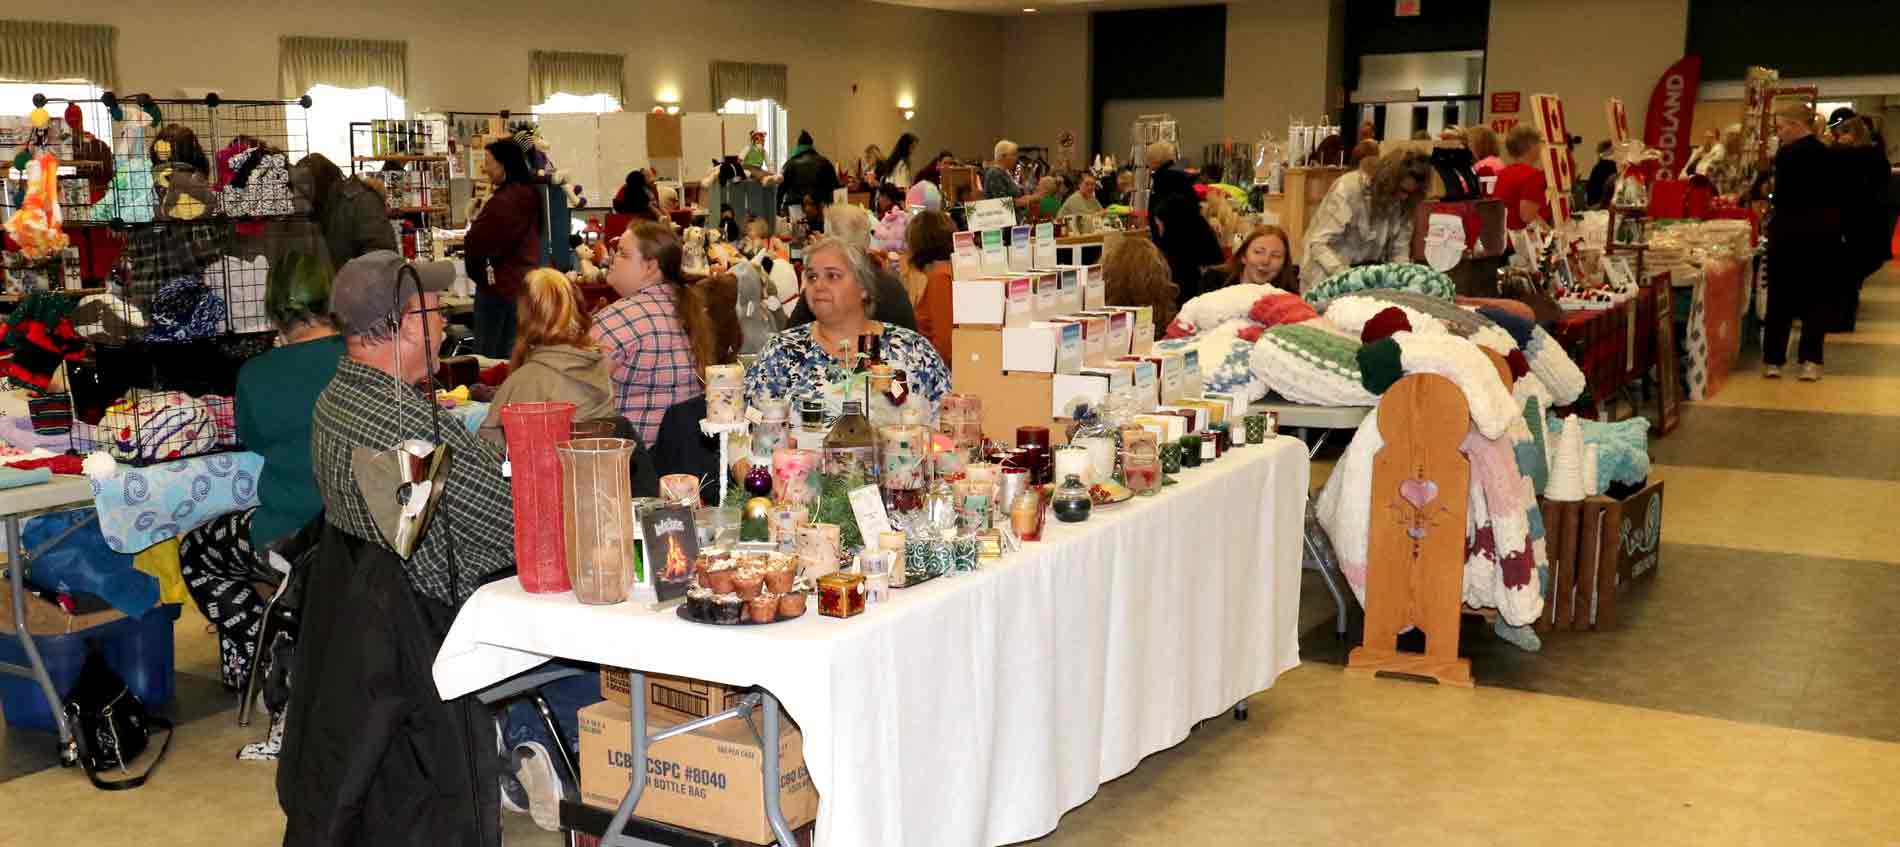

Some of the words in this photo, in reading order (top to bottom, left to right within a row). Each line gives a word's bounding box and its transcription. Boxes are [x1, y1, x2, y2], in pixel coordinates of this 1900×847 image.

[1655, 74, 1684, 181] OODLAND
[608, 749, 632, 768] LCB
[646, 758, 681, 779] CSPC
[684, 766, 727, 790] #8040
[655, 778, 686, 794] BOTTLE
[688, 784, 706, 799] BAG
